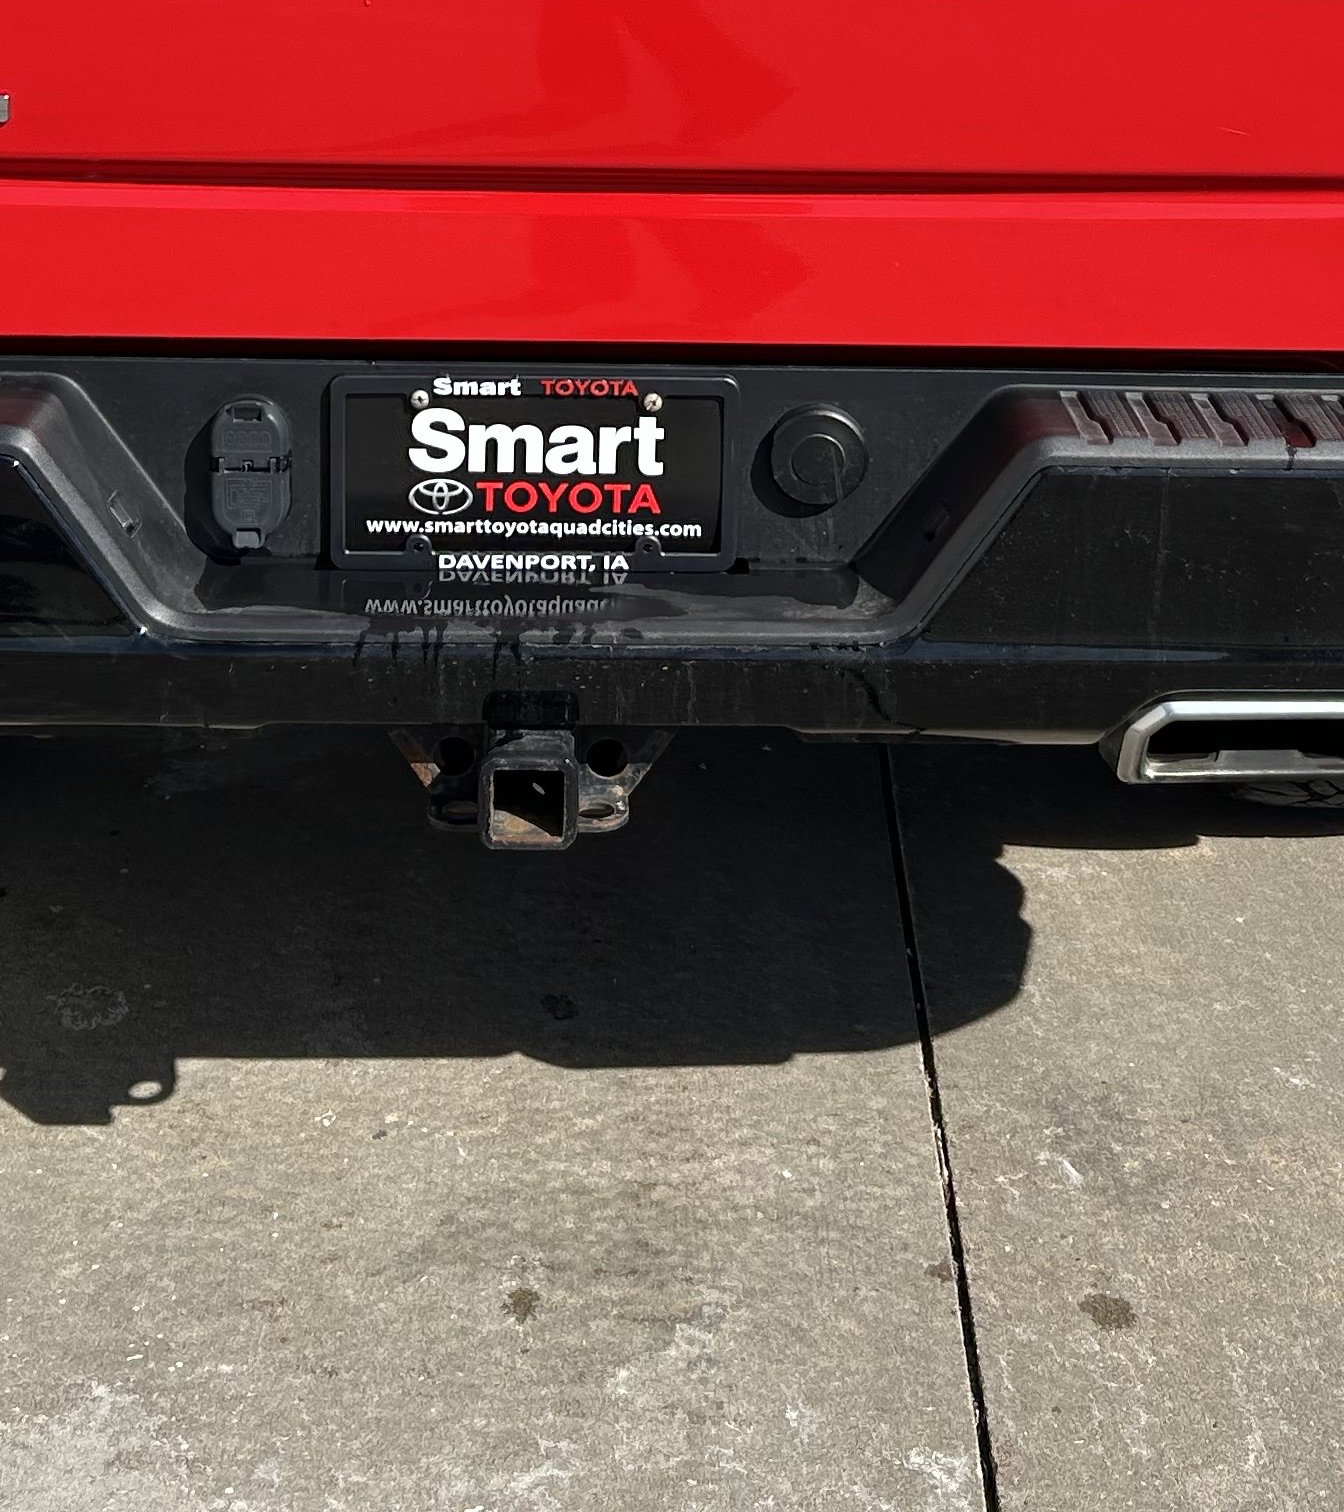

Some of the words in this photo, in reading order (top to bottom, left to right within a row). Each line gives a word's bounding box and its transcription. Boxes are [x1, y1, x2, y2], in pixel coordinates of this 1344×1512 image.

[432, 374, 522, 397] Smart
[540, 378, 640, 397] TOYOTA
[408, 407, 665, 476] Smart
[475, 481, 661, 515] TOYOTA
[366, 517, 702, 539] www.smarttoyotaquadcities.com
[438, 553, 596, 573] DAVENPORT,
[603, 554, 630, 571] IA
